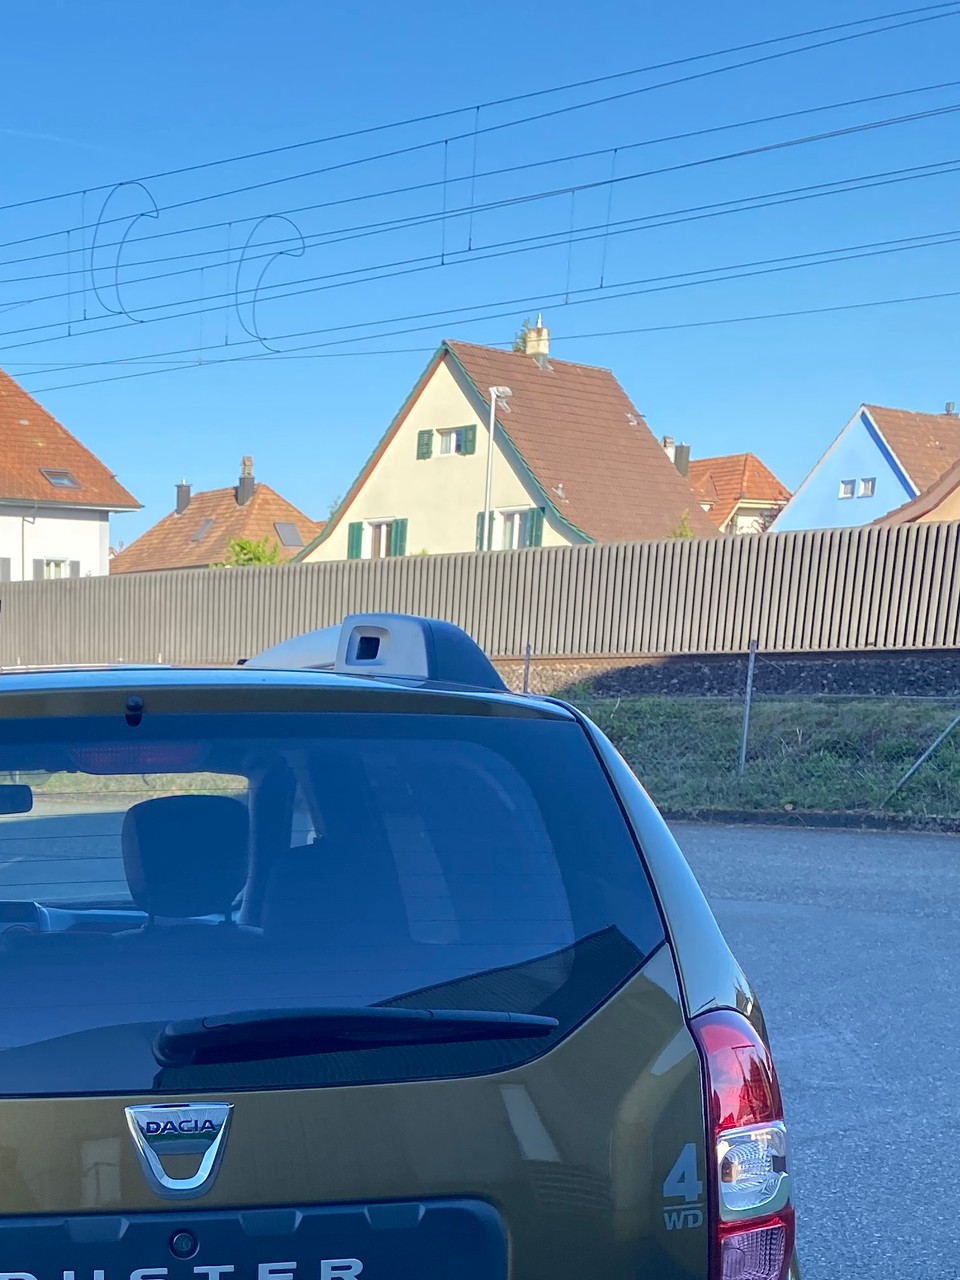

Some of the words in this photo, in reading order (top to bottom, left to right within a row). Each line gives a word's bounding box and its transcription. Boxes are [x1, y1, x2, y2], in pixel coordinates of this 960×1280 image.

[146, 1119, 217, 1135] DACIA
[662, 1142, 703, 1202] 4
[663, 1209, 704, 1230] WD
